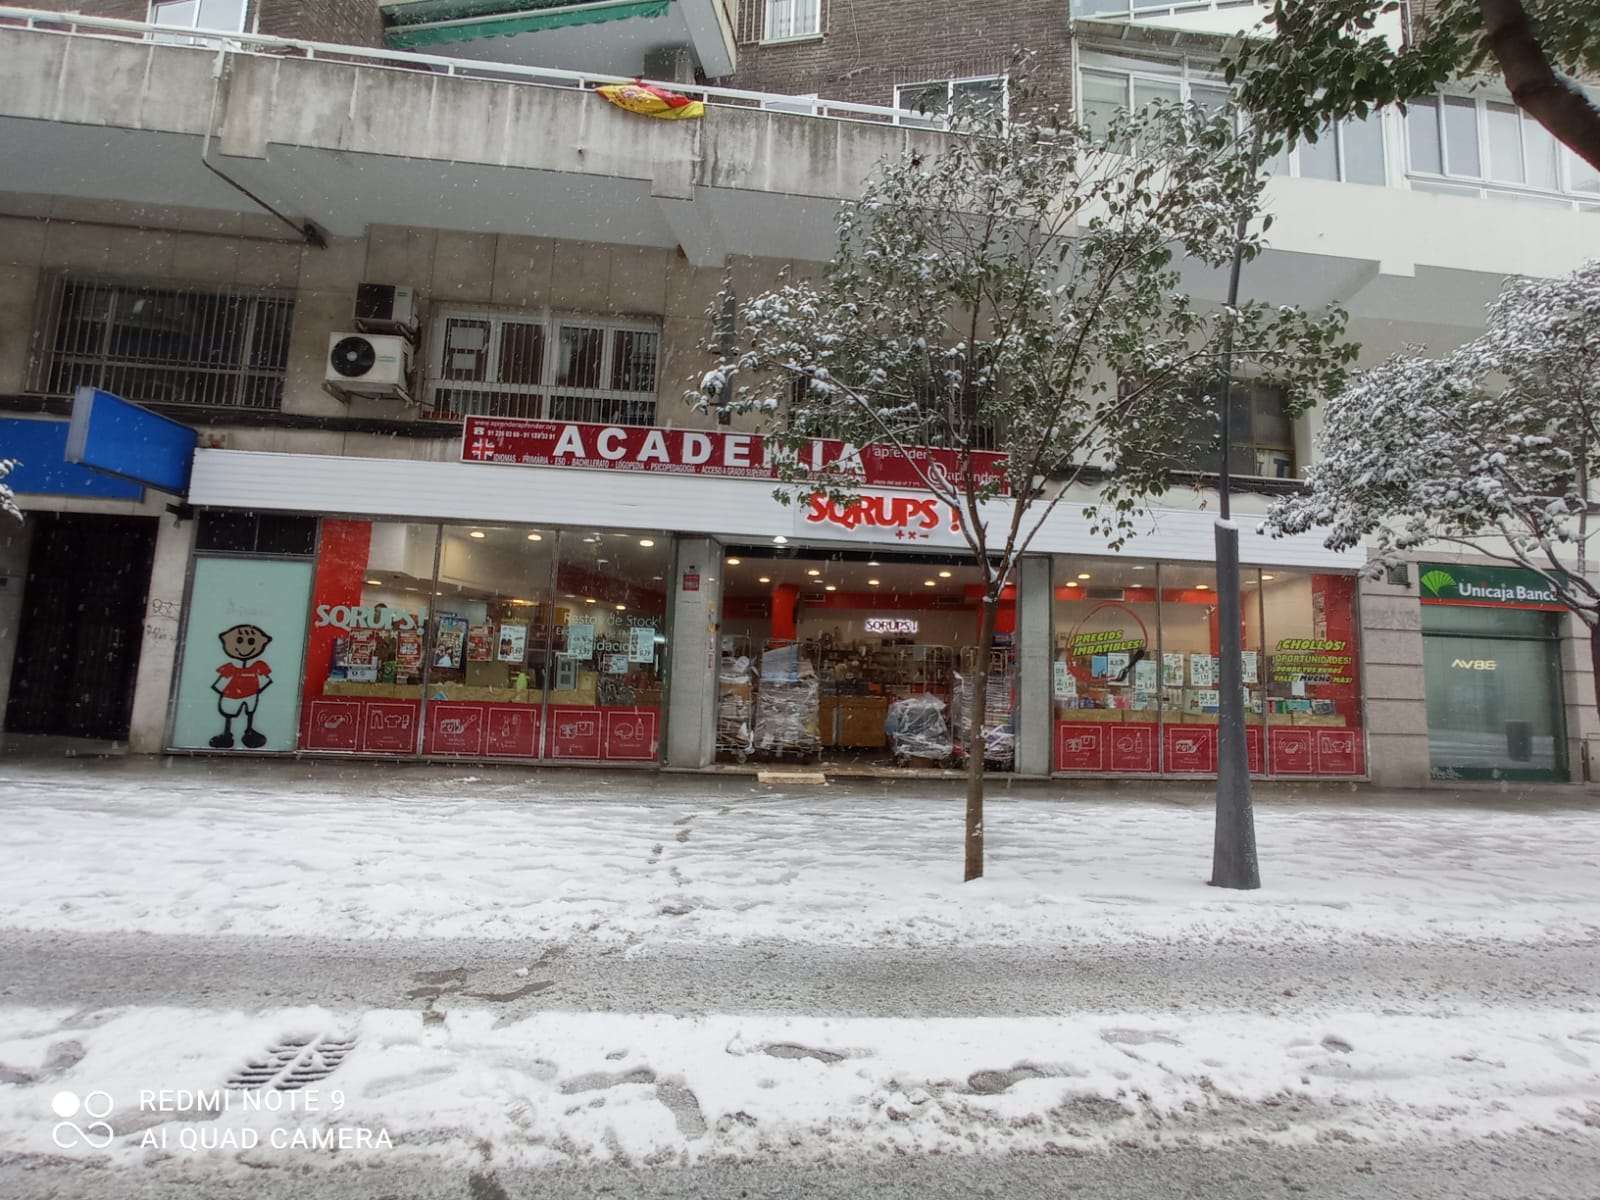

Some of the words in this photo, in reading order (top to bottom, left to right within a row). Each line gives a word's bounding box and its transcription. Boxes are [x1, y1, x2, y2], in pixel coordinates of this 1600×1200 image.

[552, 425, 866, 475] ACADEMIA
[494, 453, 517, 463] IDIOMAS
[572, 458, 609, 468] BACHILLERATO
[1459, 582, 1514, 602] Unicaja
[315, 604, 427, 636] SQRUPS!
[607, 613, 623, 626] de
[1073, 640, 1144, 656] IMBATIBLES!
[1276, 639, 1346, 651] ¡CHOLLOS!
[1272, 654, 1352, 665] ¡OPORTUNIDADES!
[1300, 674, 1332, 683] MUCHO
